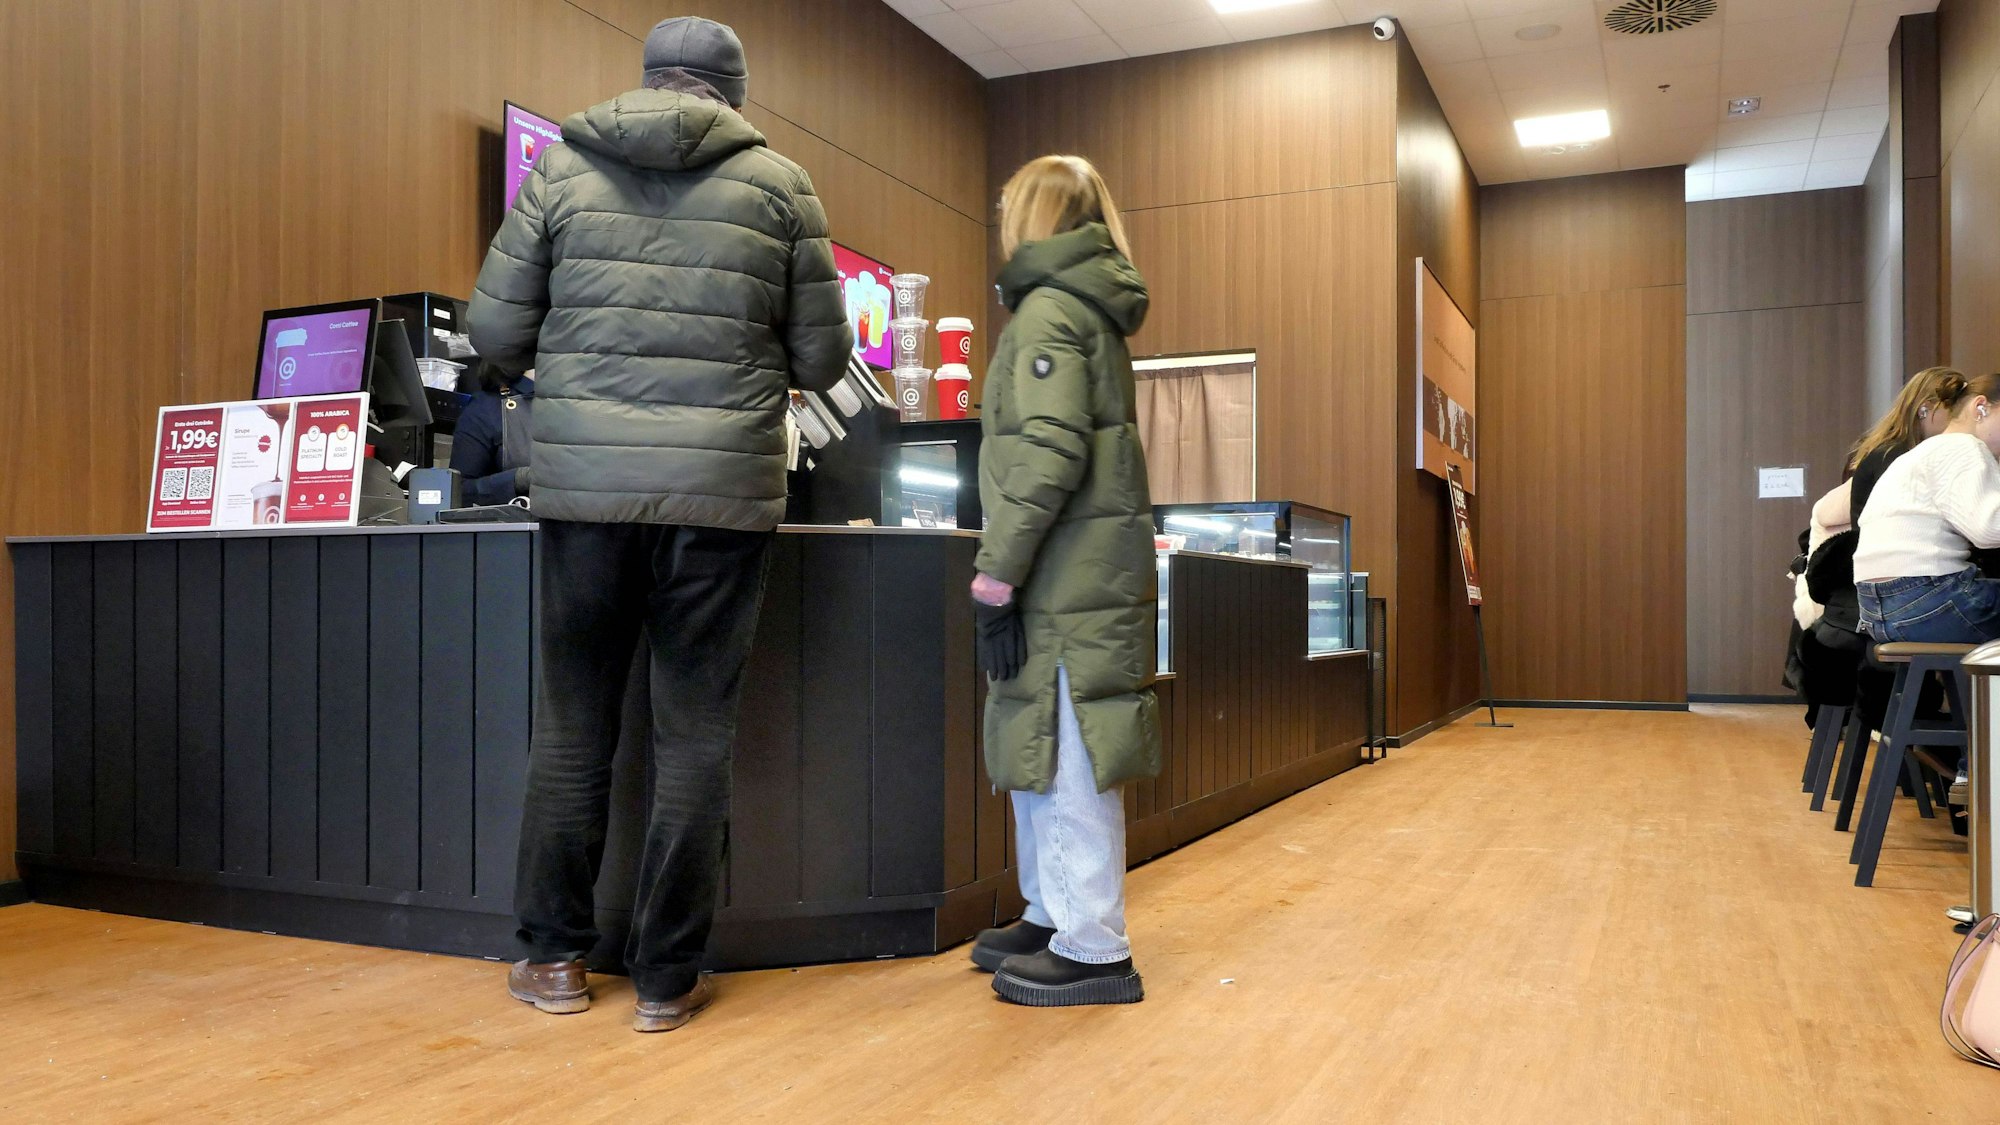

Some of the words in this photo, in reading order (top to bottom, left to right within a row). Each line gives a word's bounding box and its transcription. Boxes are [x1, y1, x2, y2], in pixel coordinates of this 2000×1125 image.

[513, 116, 535, 131] Unsere
[324, 409, 350, 417] ARABICA
[170, 428, 219, 454] 1,99€
